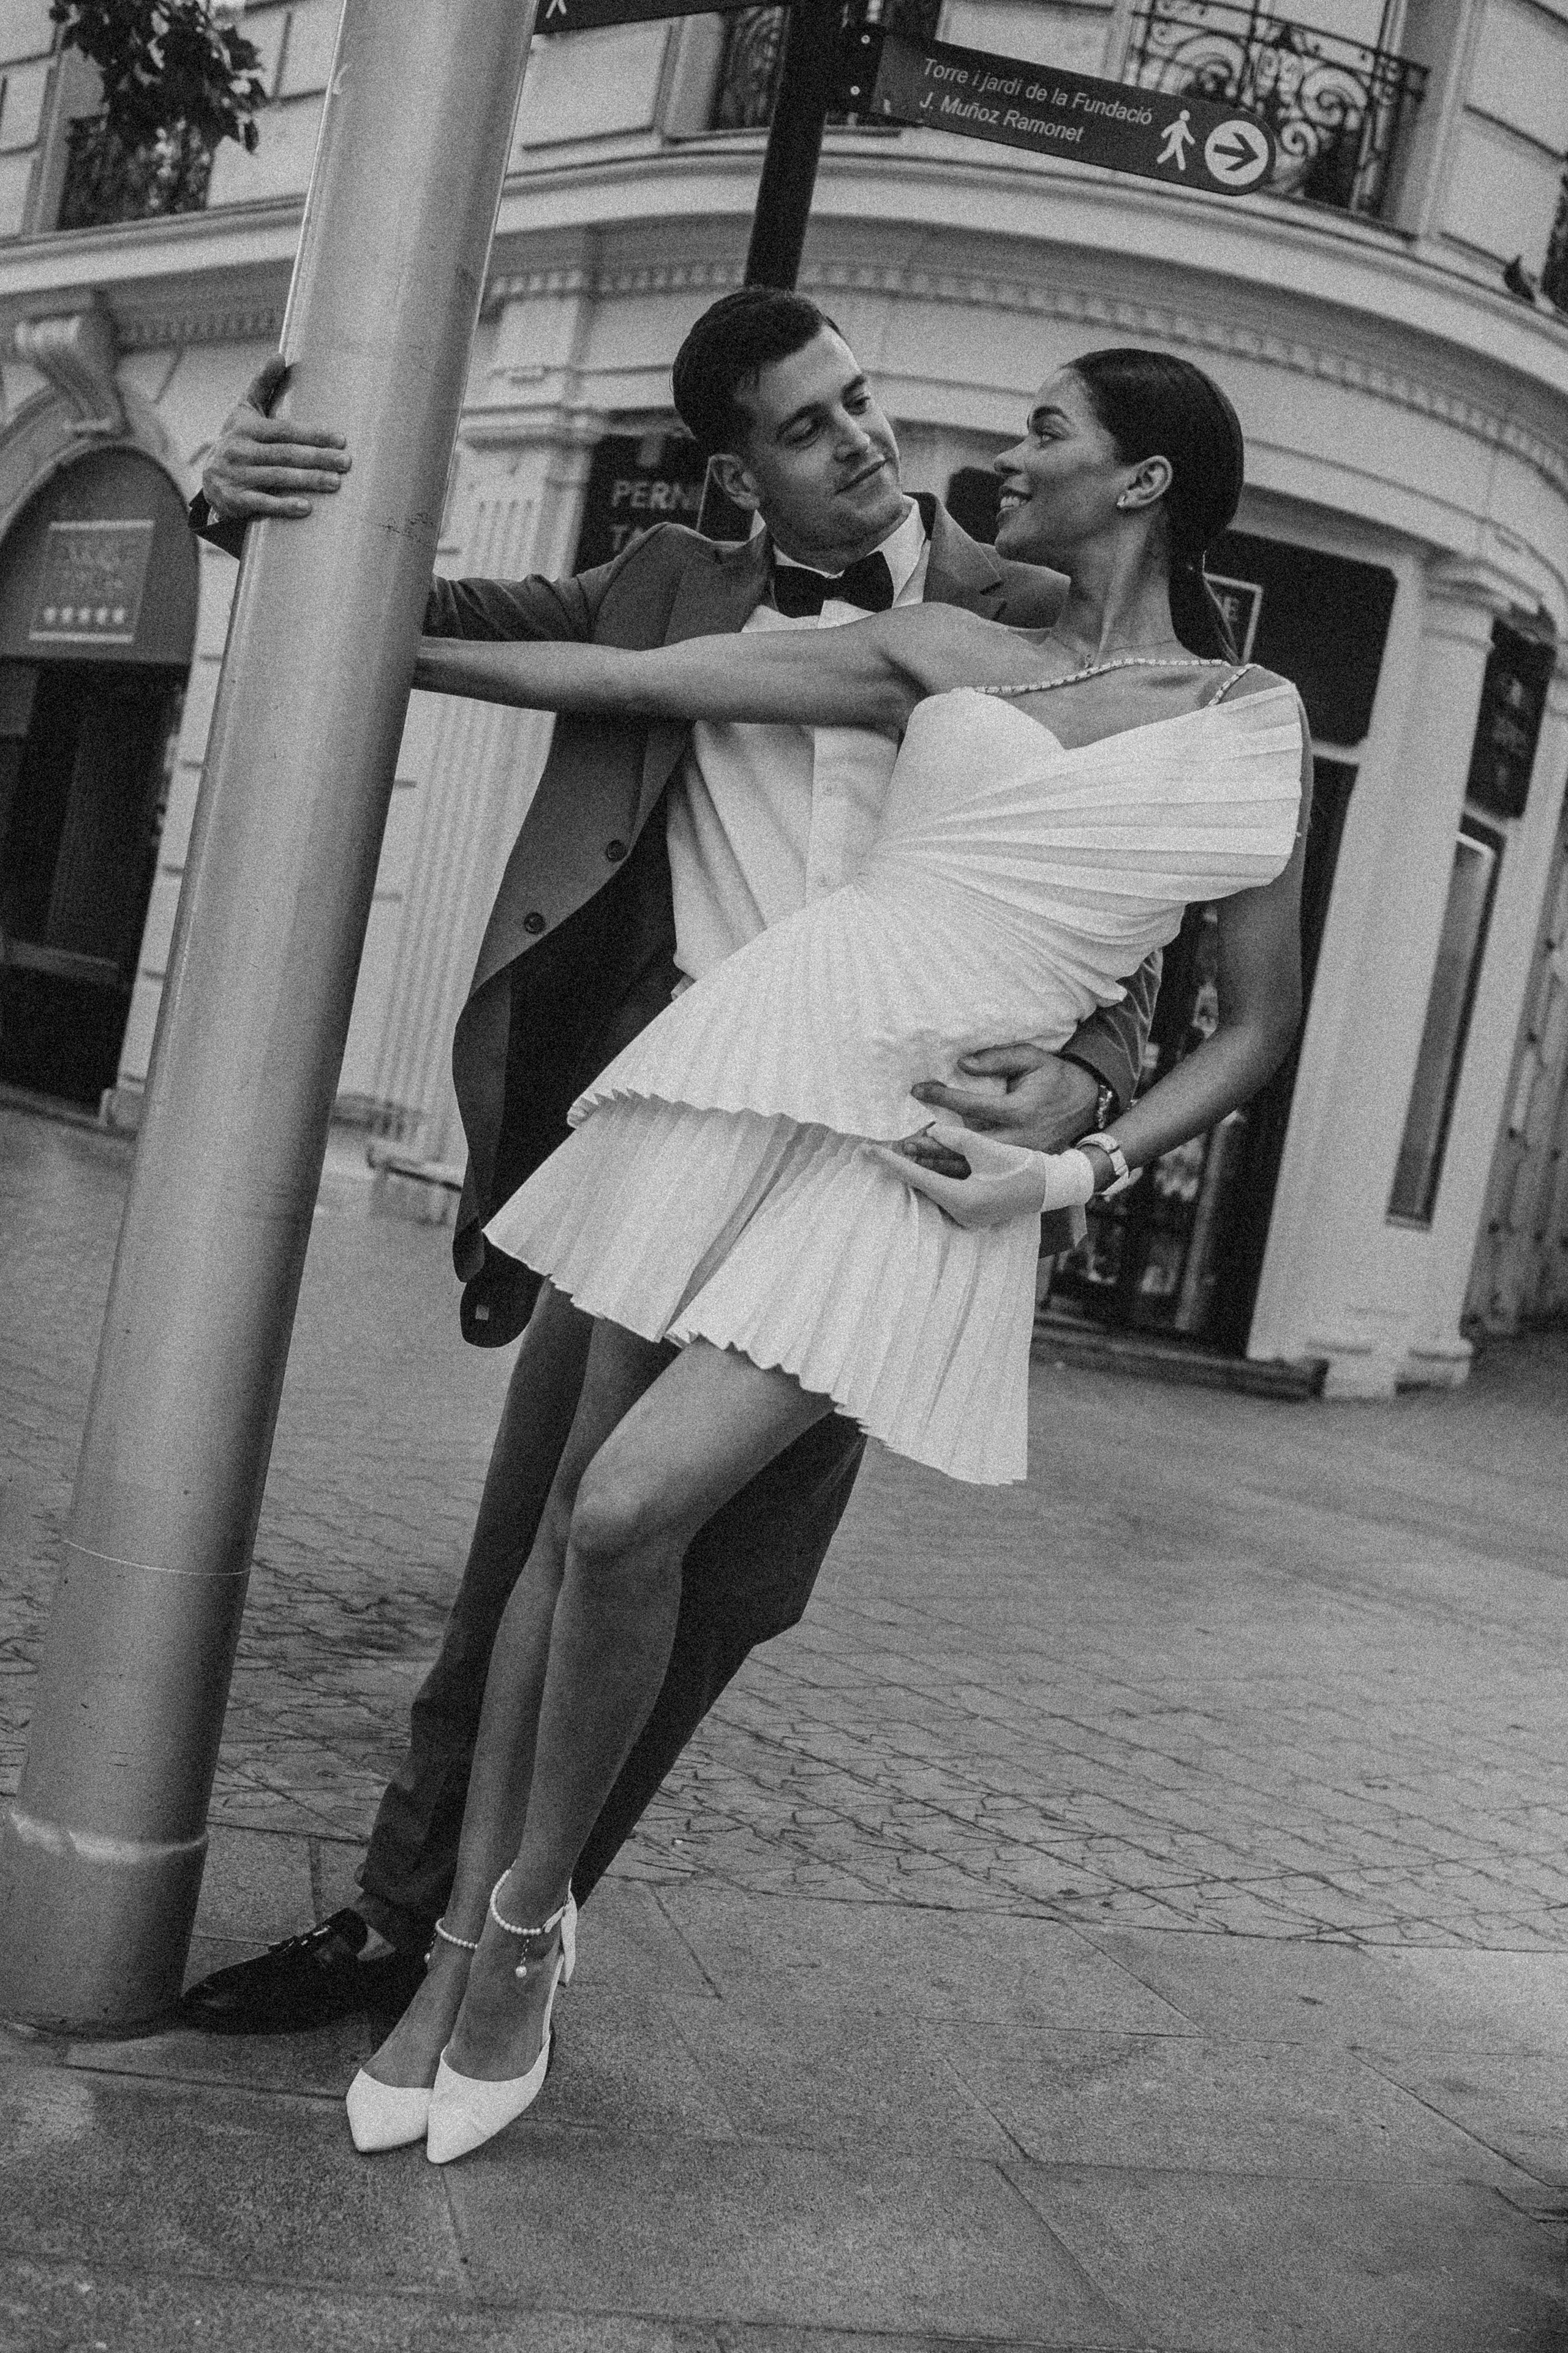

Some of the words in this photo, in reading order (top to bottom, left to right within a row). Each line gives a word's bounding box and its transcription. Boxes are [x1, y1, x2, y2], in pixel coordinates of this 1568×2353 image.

[919, 91, 934, 110] J.
[940, 96, 1000, 124] Muñoz
[1003, 110, 1085, 142] Ramonet
[924, 58, 968, 83] Torre
[972, 69, 981, 86] i
[1025, 84, 1047, 102] de
[1051, 88, 1068, 106] la
[1071, 92, 1153, 126] Fundació
